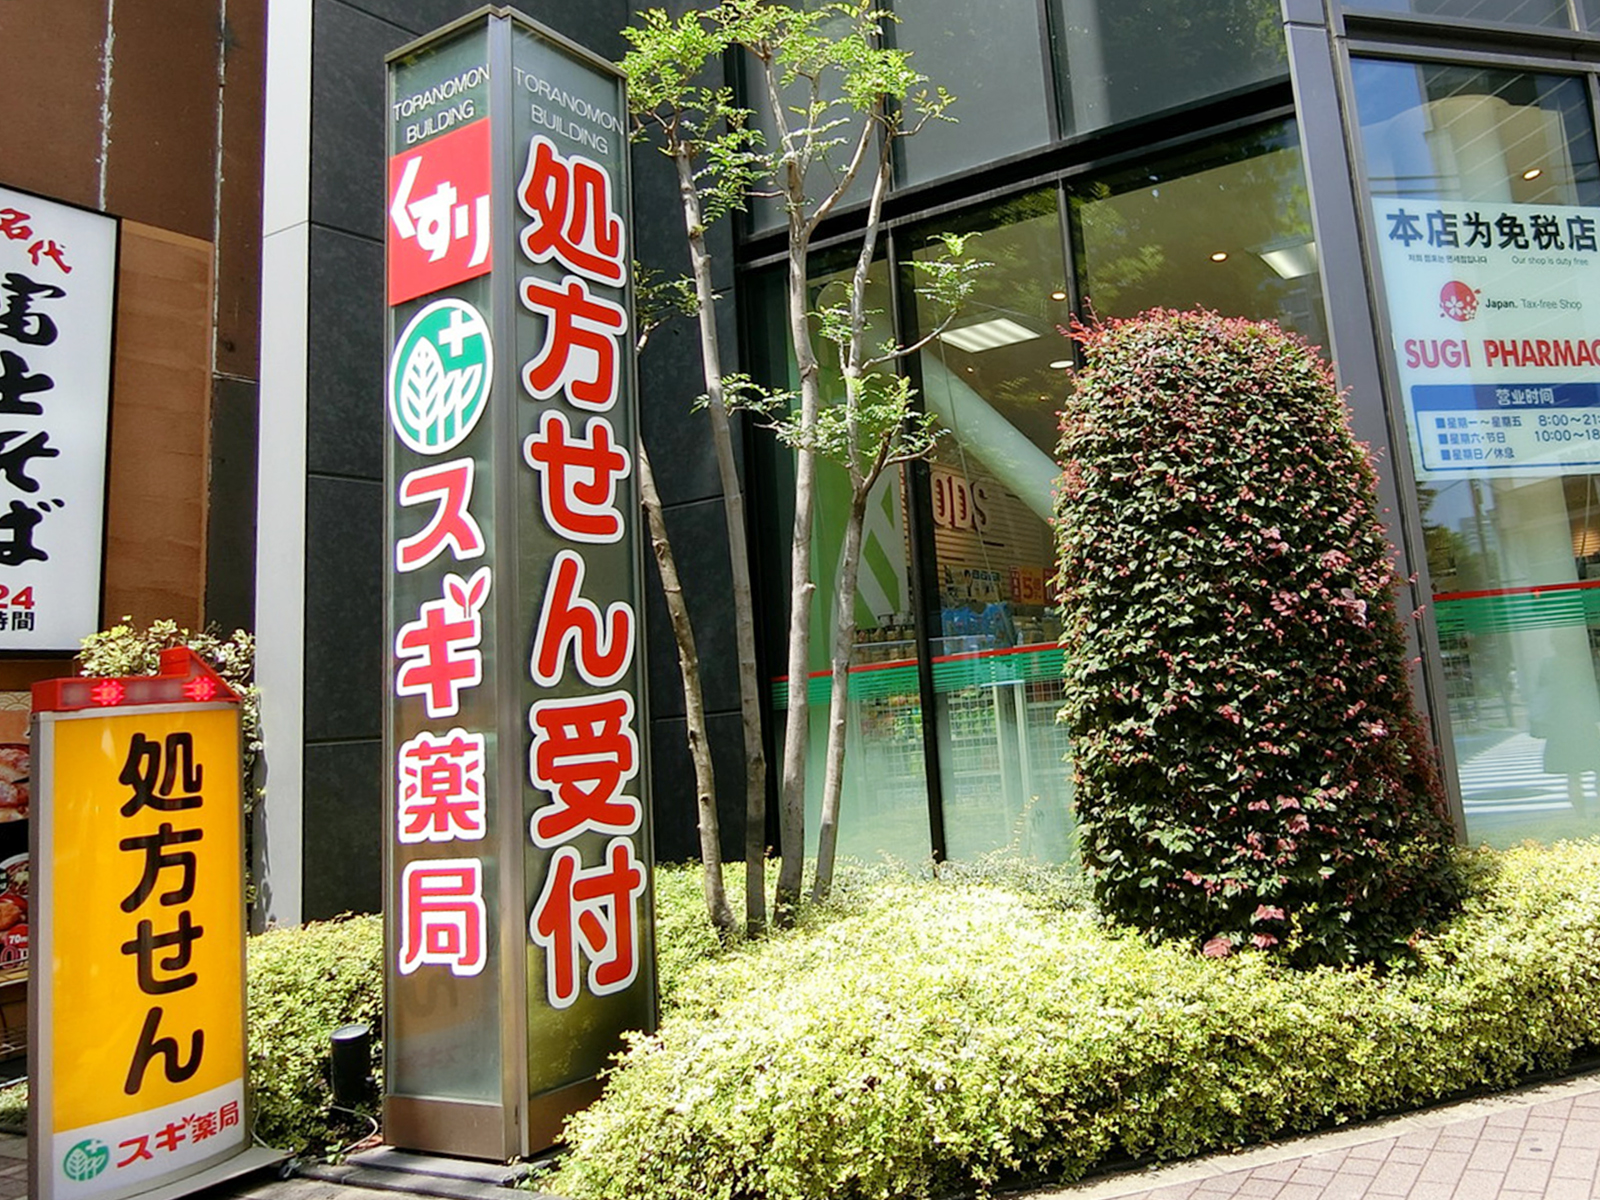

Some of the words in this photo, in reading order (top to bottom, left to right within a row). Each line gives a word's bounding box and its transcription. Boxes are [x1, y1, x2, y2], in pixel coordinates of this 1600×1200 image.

[393, 64, 490, 122] TORANOMON
[513, 66, 624, 136] TORANOMON
[406, 100, 475, 145] BUILDING
[531, 103, 609, 155] BUILDING
[390, 155, 490, 269] くすり
[1386, 208, 1598, 252] 本店为免税店
[1511, 255, 1526, 265] Our
[1528, 256, 1547, 267] shop
[1547, 256, 1554, 265] is
[1556, 257, 1572, 267] duty
[1573, 256, 1589, 266] free
[1521, 299, 1557, 309] Tax-free
[1559, 300, 1583, 311] Shop
[1404, 339, 1471, 368] SUGI
[1496, 388, 1555, 406] 营业时间
[517, 134, 648, 1010] 処方せん受付
[396, 457, 491, 977] スギ薬局
[118, 732, 204, 1095] 処方せん
[117, 1100, 240, 1169] スギ薬局
